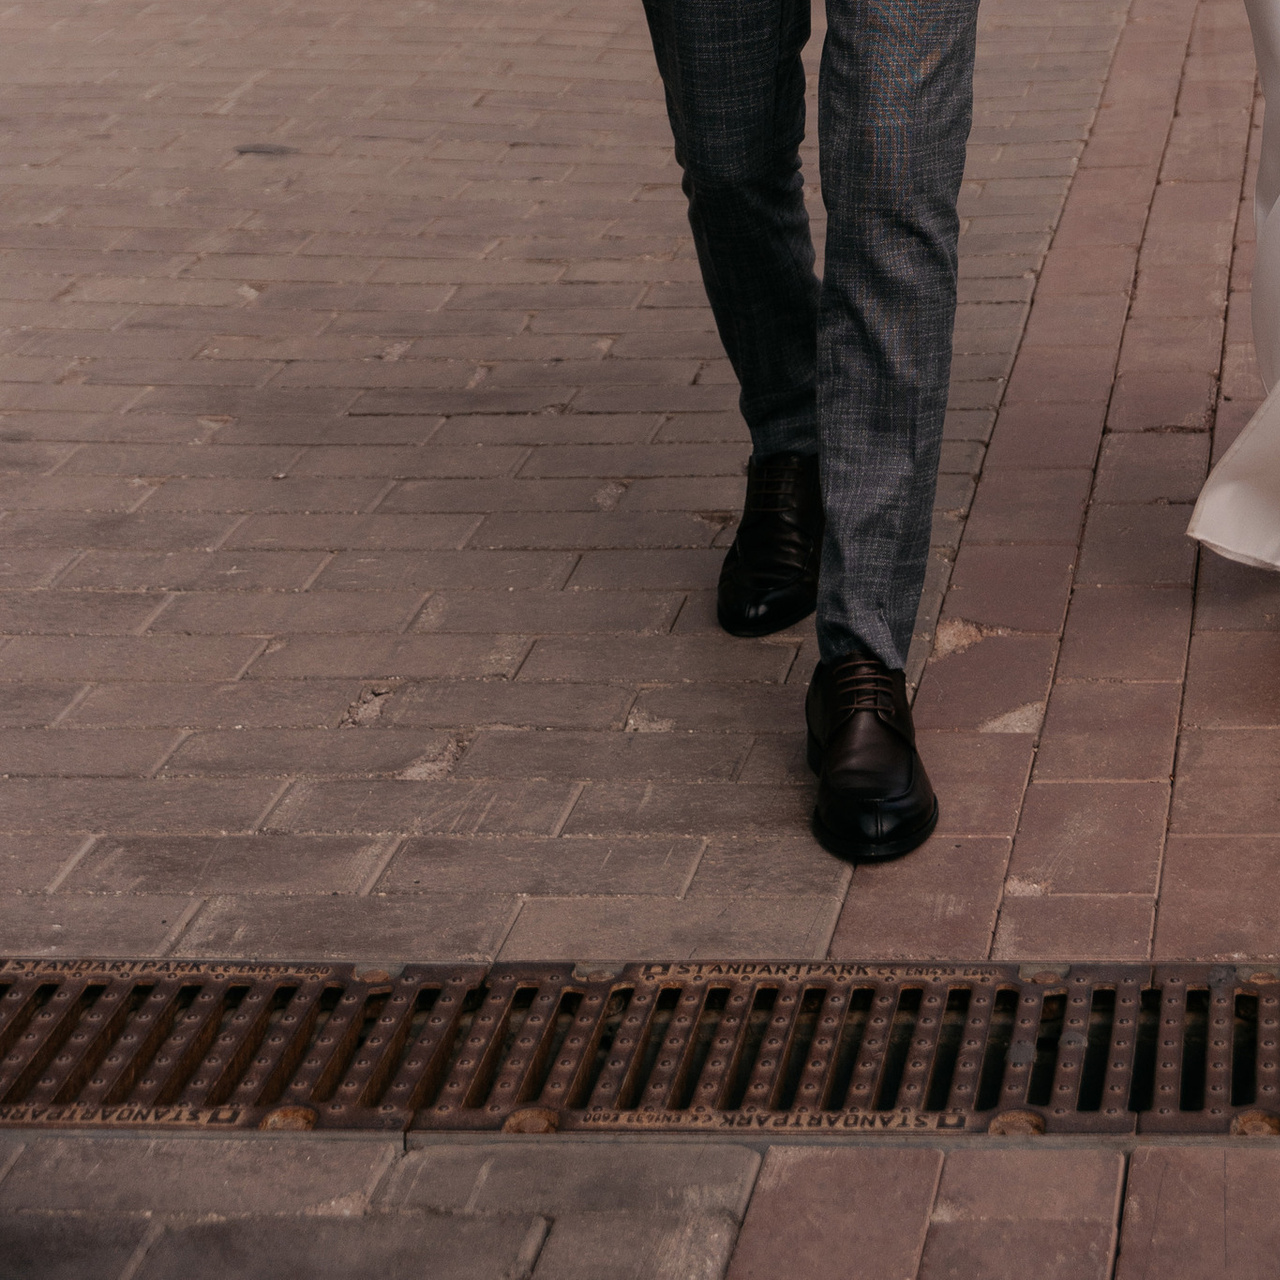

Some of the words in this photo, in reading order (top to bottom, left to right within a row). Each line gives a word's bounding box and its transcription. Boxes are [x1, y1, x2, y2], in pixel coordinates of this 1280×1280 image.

[12, 959, 205, 973] STANDARTPARK
[676, 964, 870, 976] STANDARTPARK
[718, 1113, 930, 1128] STANDARTPARK
